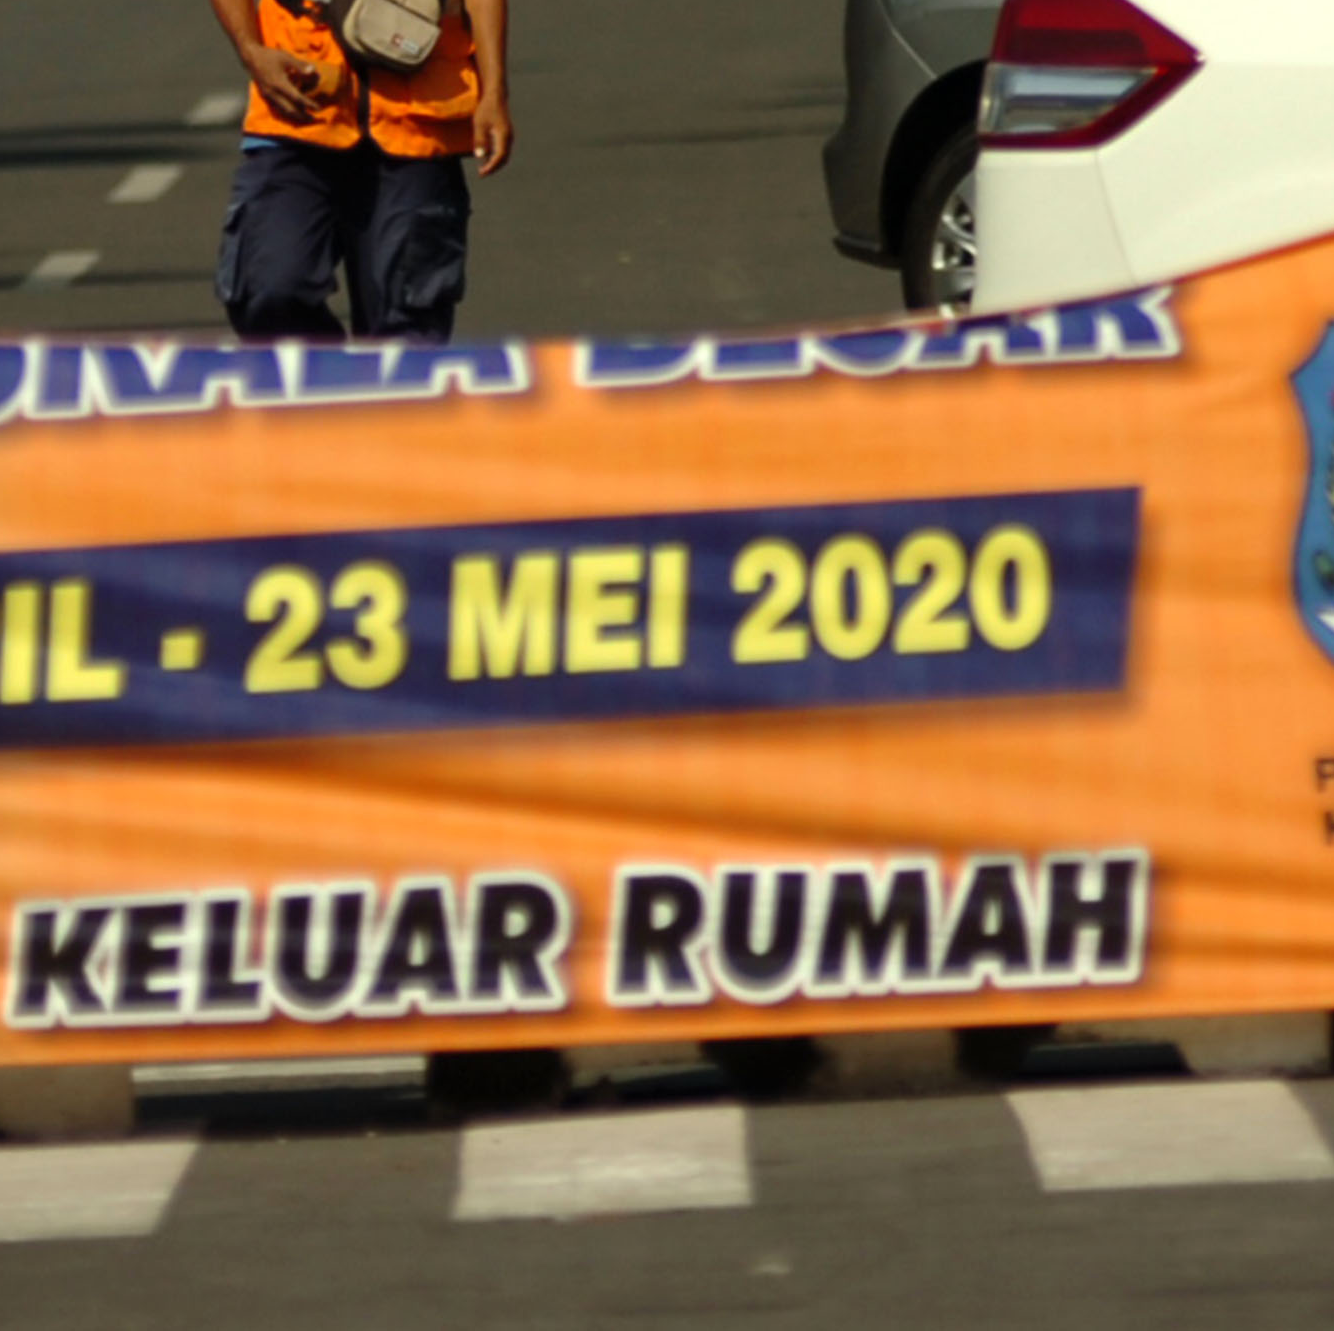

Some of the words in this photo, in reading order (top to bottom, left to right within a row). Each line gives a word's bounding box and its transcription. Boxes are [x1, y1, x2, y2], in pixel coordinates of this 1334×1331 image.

[244, 562, 408, 694] 23
[448, 543, 689, 682] MEI
[730, 524, 1053, 664] 2020
[5, 876, 572, 1026] KELUAR
[606, 847, 1150, 1006] RUMAH
